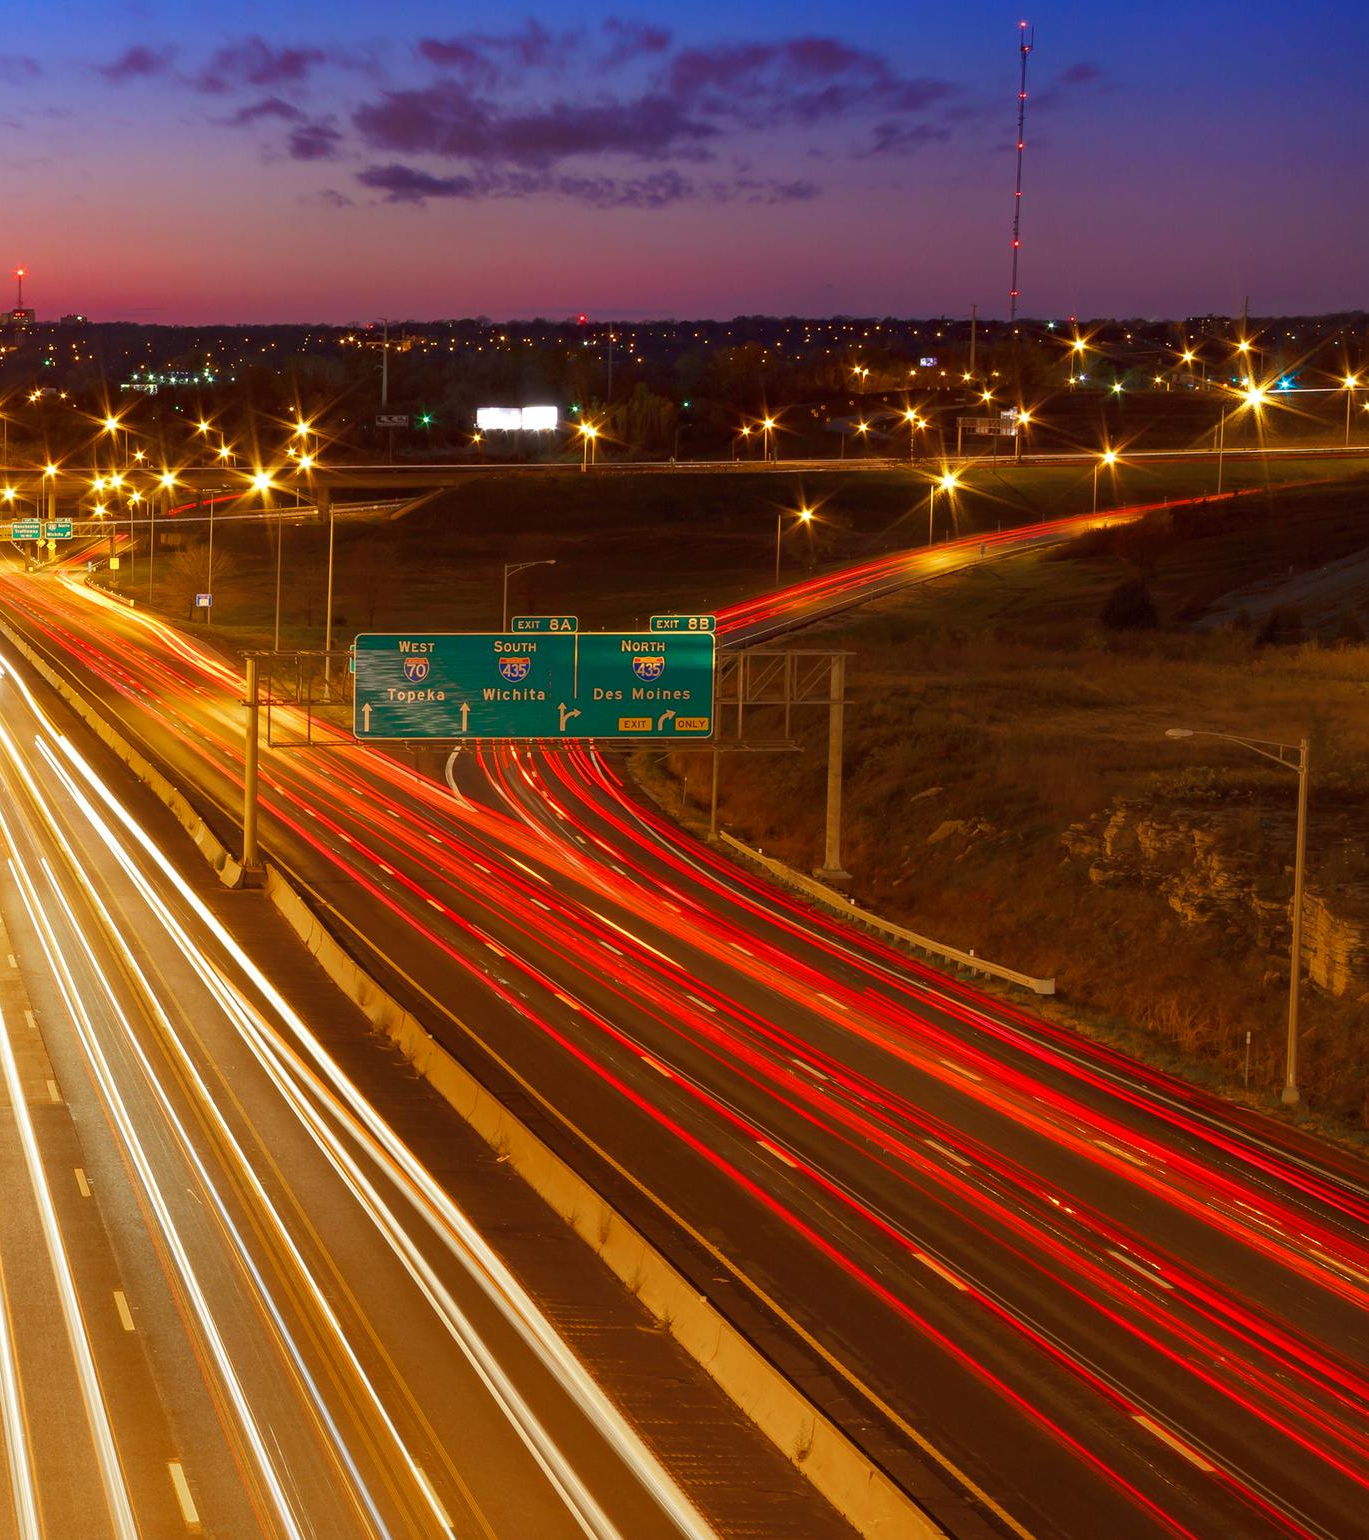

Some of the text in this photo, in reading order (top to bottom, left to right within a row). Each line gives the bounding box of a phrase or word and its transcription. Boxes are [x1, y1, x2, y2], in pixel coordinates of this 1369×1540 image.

[517, 618, 571, 631] EXIT 8A
[656, 618, 709, 630] EXIT 8B
[399, 640, 435, 653] WEST
[493, 640, 537, 653] SOUTH
[621, 639, 665, 652] NORTH
[406, 663, 427, 678] 70
[502, 663, 527, 678] 435
[637, 662, 661, 677] 435
[387, 688, 446, 704] Topeka
[483, 688, 546, 701] Wichita
[593, 687, 691, 700] Des Moines
[624, 719, 706, 729] EXIT ONLY
